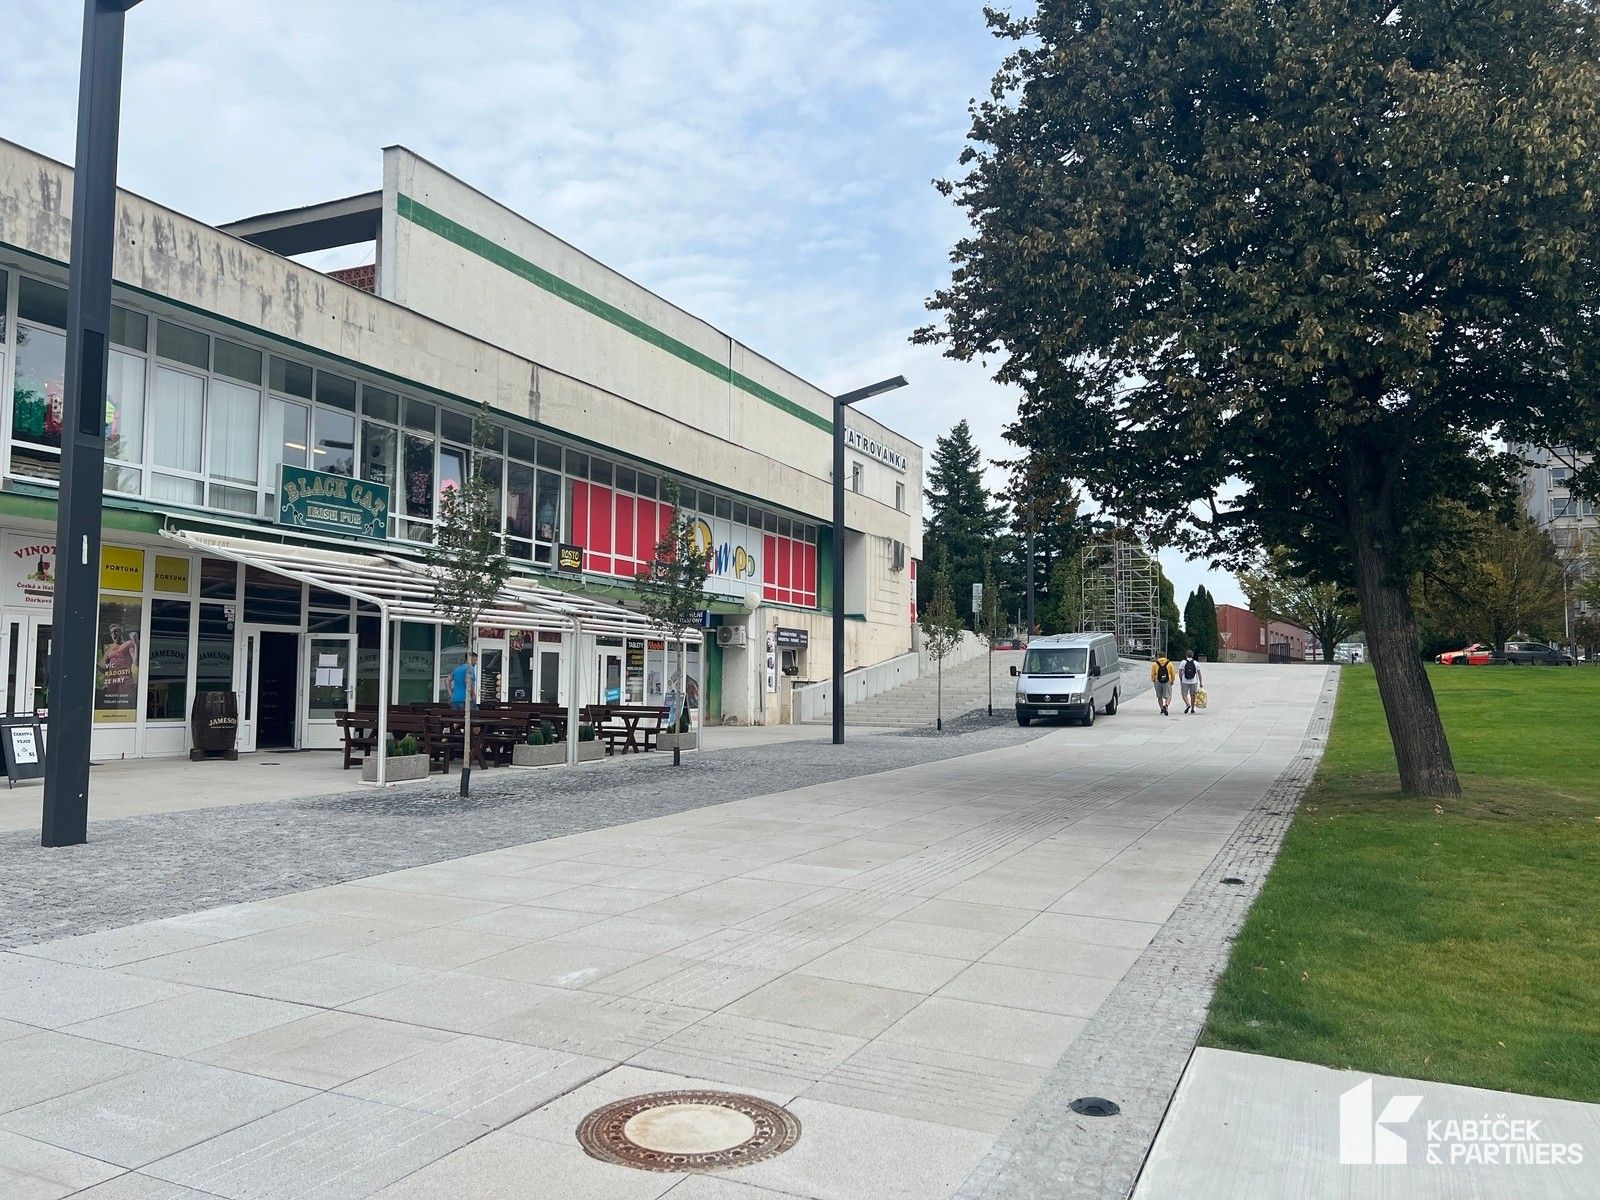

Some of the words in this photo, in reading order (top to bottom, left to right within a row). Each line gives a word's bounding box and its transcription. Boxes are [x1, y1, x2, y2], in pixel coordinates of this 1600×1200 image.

[283, 476, 348, 503] BLACK
[351, 484, 386, 517] CAT
[307, 505, 338, 521] IRISH
[340, 511, 361, 525] PUB
[105, 564, 139, 573] FORTUNA
[155, 573, 187, 582] FORTUNA
[151, 650, 185, 660] JAMESON
[199, 651, 231, 661] JAMESON
